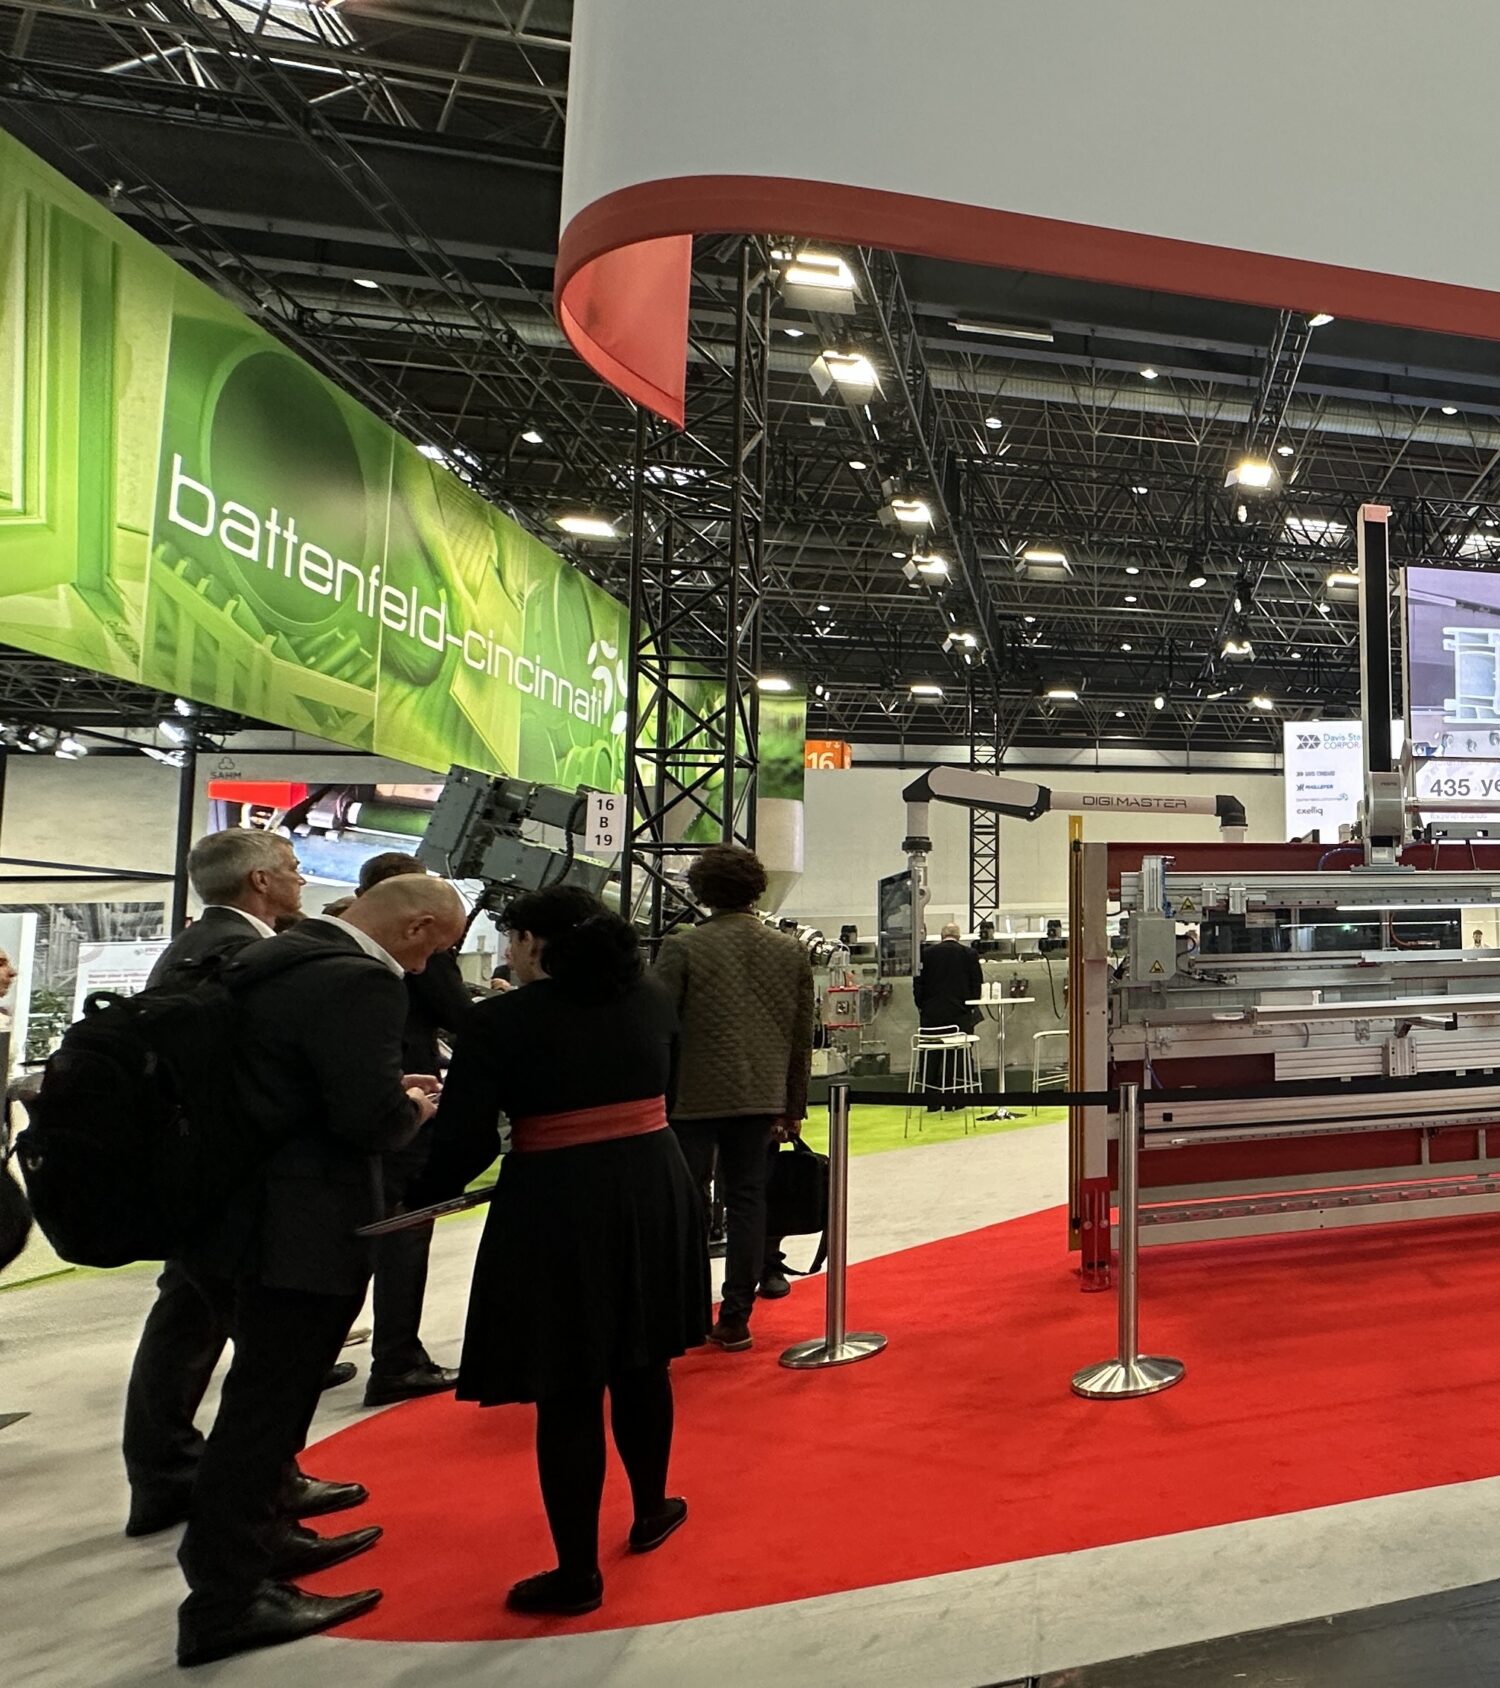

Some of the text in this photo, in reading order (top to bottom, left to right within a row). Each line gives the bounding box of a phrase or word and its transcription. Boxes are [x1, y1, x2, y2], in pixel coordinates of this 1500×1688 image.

[167, 452, 603, 729] battenfeld-cincinnati
[806, 752, 835, 769] 16
[1430, 778, 1471, 797] 435
[596, 798, 615, 811] 16
[599, 816, 609, 828] B
[594, 834, 613, 846] 19
